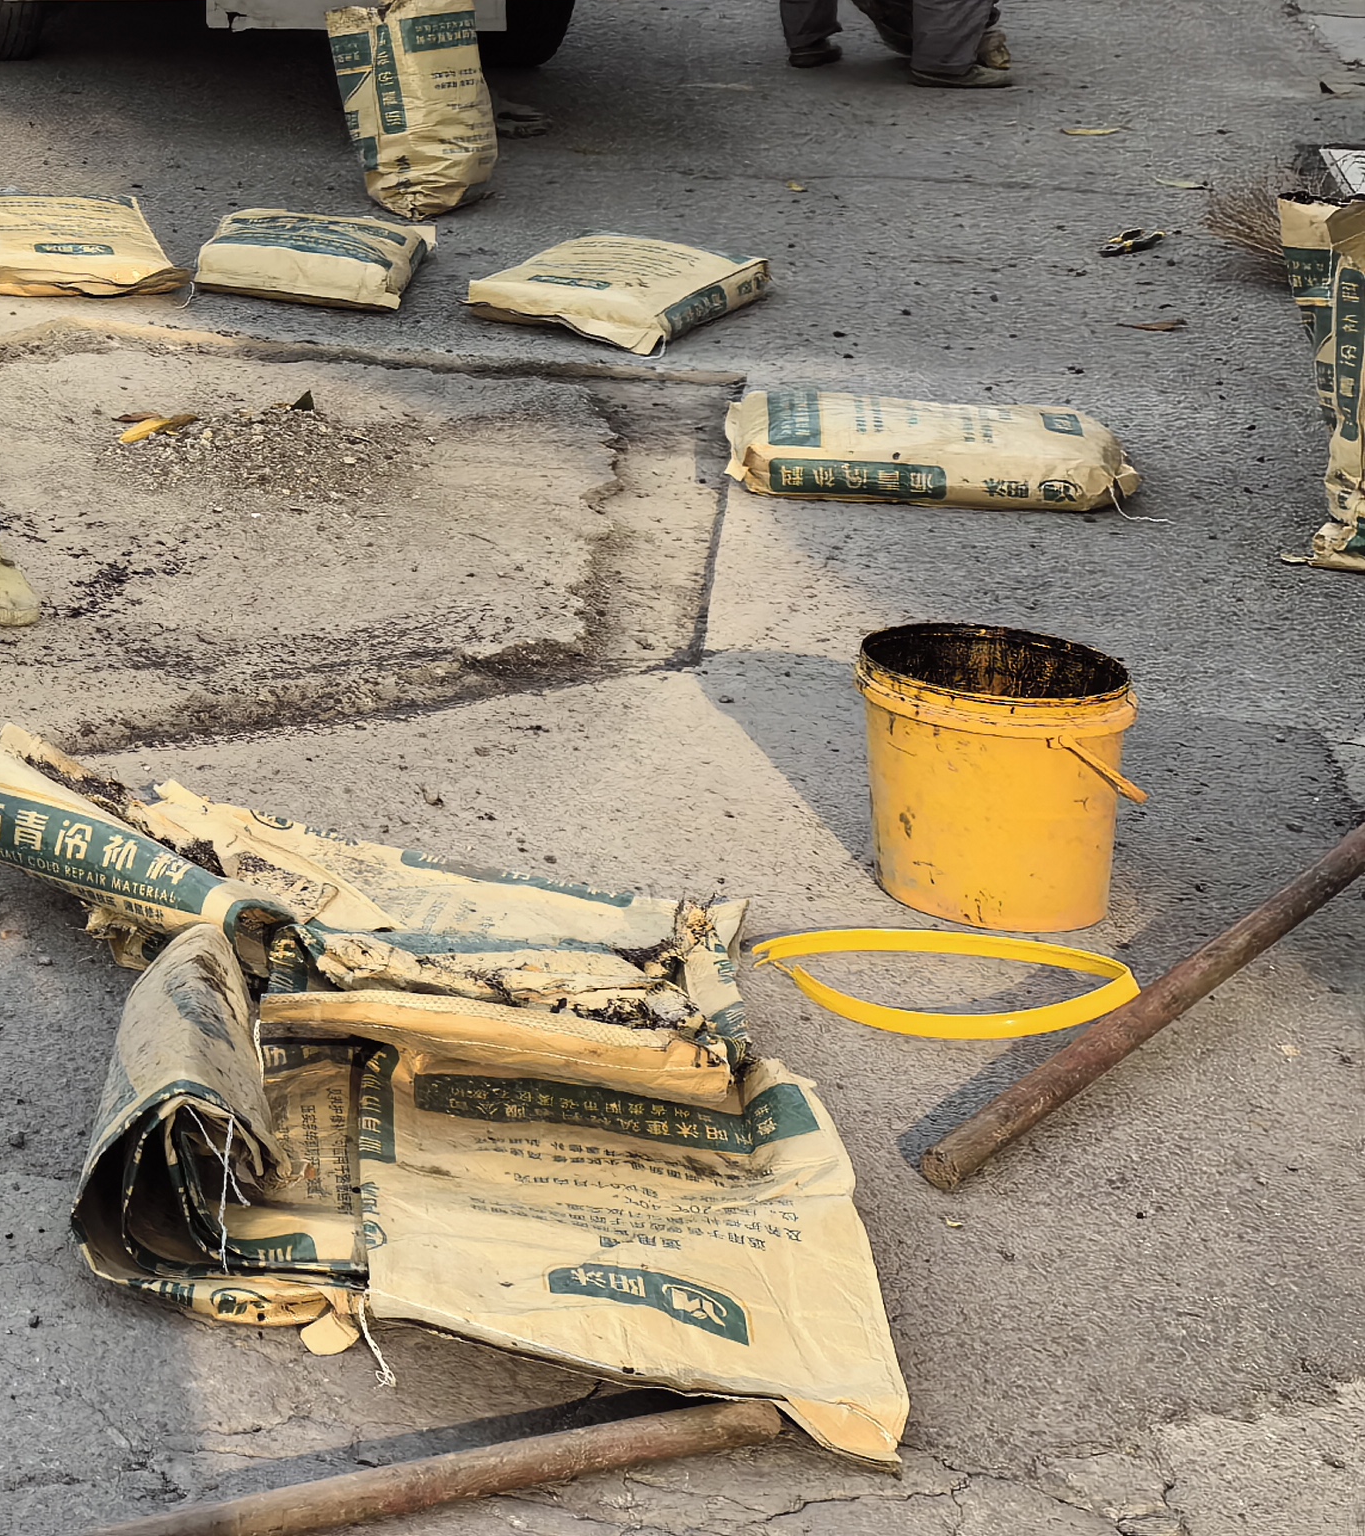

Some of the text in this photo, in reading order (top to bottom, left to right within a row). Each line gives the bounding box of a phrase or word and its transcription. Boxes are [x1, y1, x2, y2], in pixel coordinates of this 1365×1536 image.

[27, 856, 59, 874] COLD
[64, 864, 108, 887] REPAIR
[111, 876, 177, 904] MATERIAL
[570, 1267, 646, 1298] 阳沐
